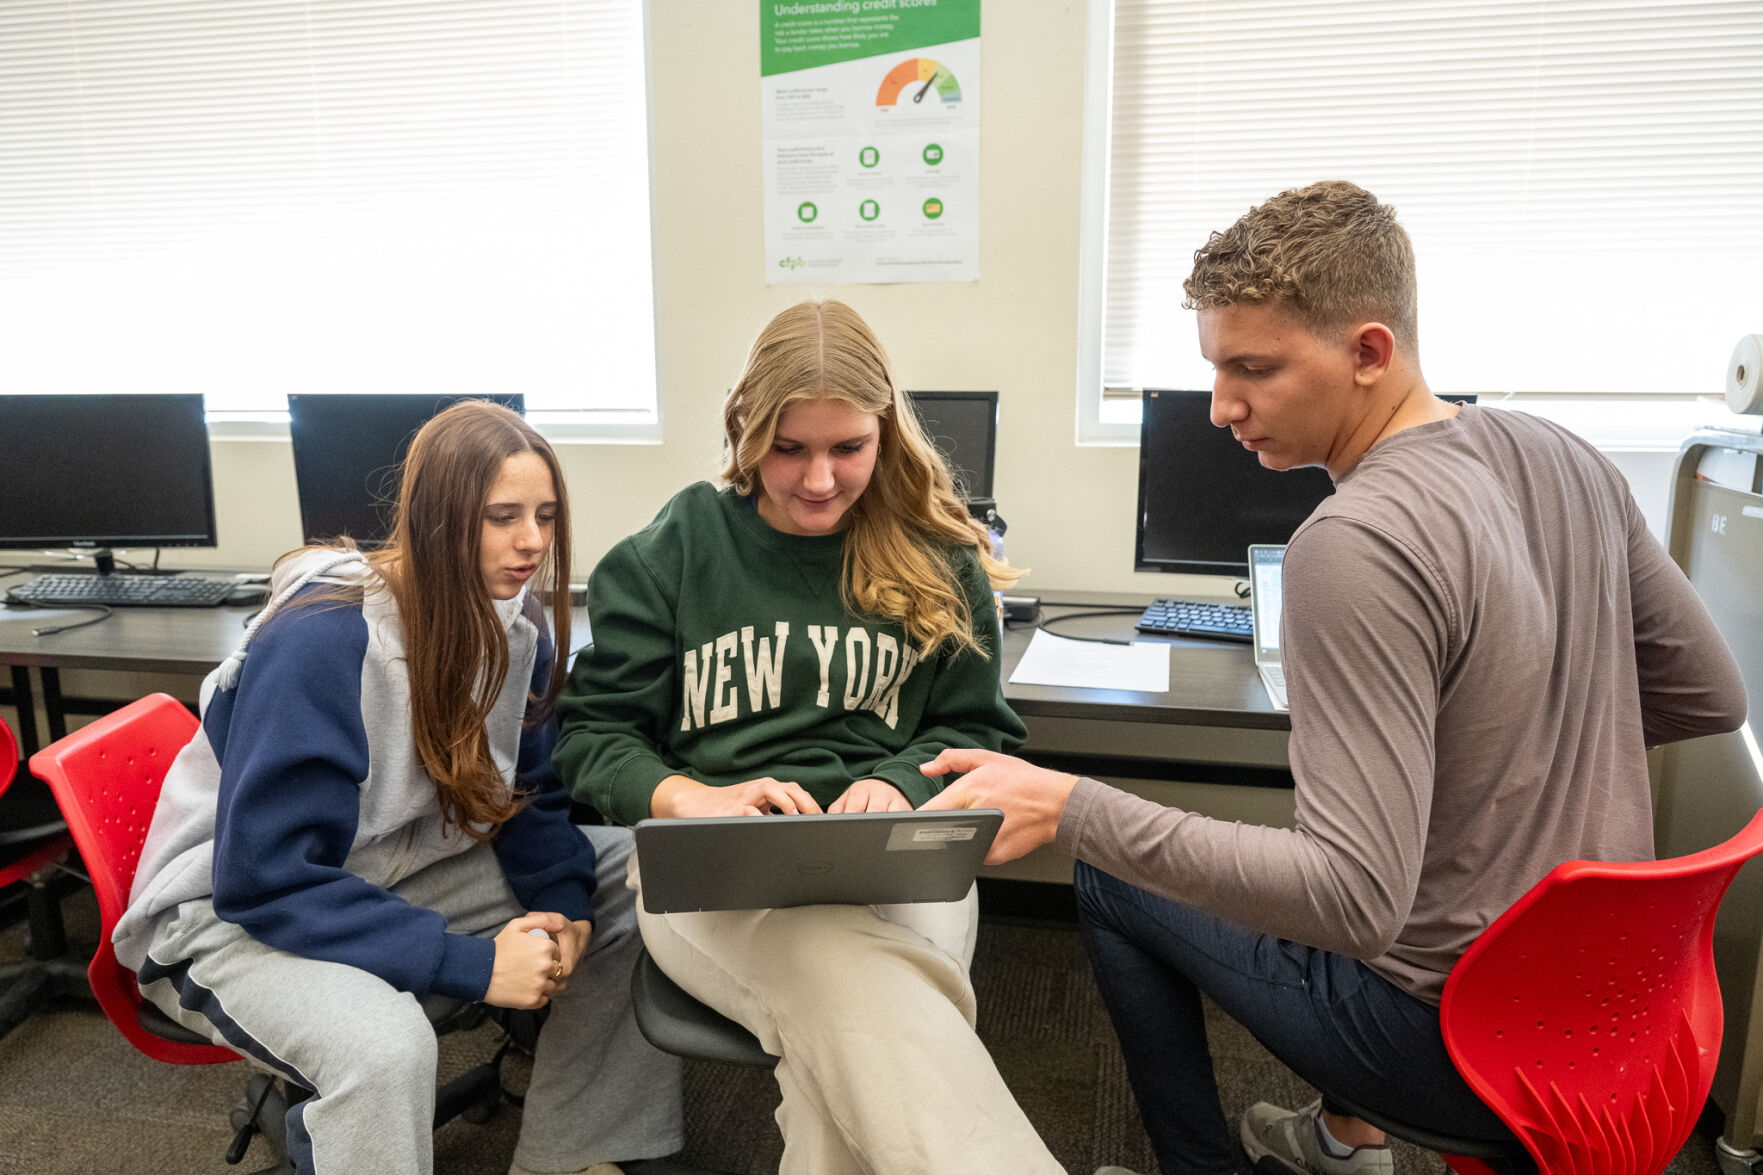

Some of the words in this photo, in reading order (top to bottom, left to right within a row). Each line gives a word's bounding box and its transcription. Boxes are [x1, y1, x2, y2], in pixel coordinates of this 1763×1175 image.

[774, 0, 859, 16] Understanding
[862, 0, 896, 10] credit
[899, 0, 938, 8] scores
[1711, 513, 1727, 535] BE
[680, 621, 789, 731] NEW
[807, 625, 919, 731] YORK
